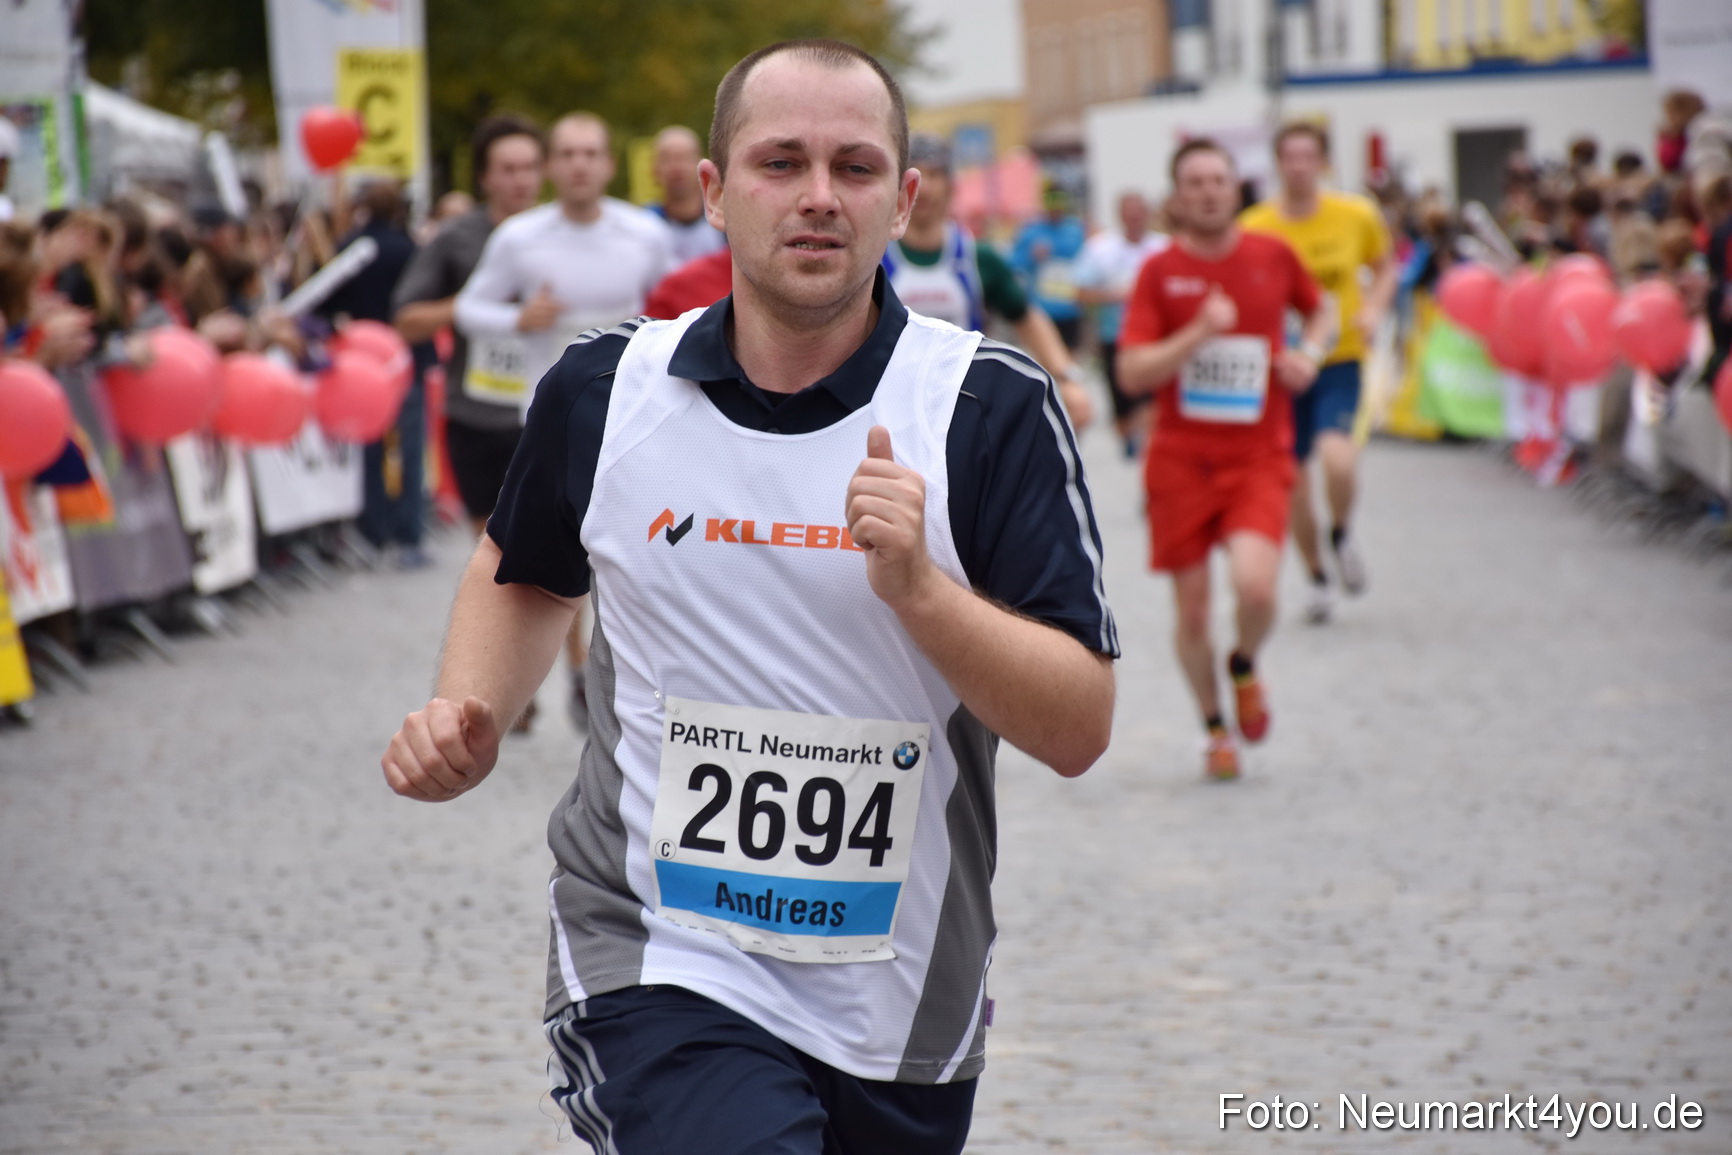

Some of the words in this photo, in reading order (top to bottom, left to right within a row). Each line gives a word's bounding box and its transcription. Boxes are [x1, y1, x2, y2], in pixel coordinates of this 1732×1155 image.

[355, 83, 399, 146] C
[670, 722, 752, 753] PARTL
[760, 734, 883, 765] Neumarkt
[679, 763, 895, 868] 2694
[715, 882, 847, 928] Andreas
